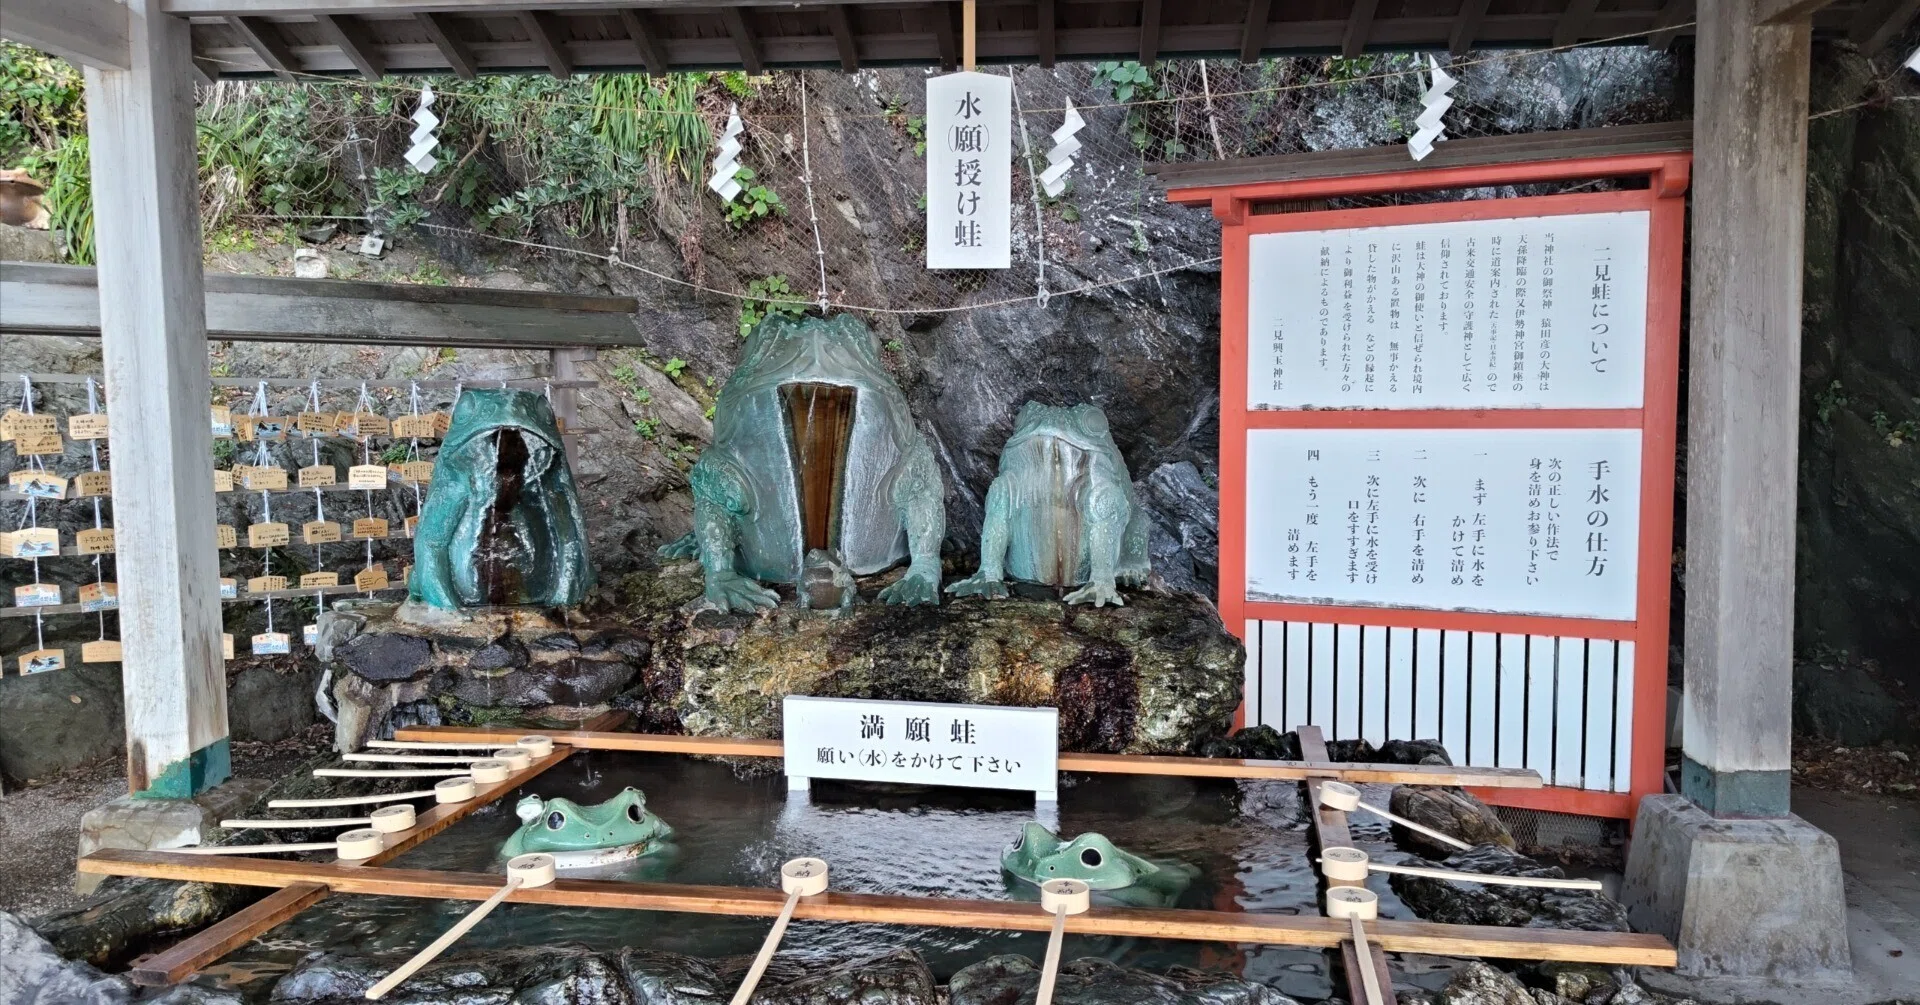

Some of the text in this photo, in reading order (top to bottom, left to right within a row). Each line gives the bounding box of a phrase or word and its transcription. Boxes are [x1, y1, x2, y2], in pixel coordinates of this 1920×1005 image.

[948, 91, 989, 247] 水（願）授け蛙
[1319, 247, 1330, 370] 献納によるものであります。
[1365, 244, 1377, 392] 貸した物がかえる などの縁起に
[1389, 243, 1401, 392] に沢山ある置物は 無事かえる
[1413, 241, 1426, 394] 蛙は大神の御使いと信ぜられ境内
[1438, 238, 1450, 335] 信仰されております。
[1462, 237, 1476, 392] 古来交通安全の守護神として広く
[1538, 233, 1554, 391] 当神社の御祭神 猿田彦の大神は
[1590, 247, 1611, 373] 二見蛙について
[1273, 319, 1283, 390] 二見興玉神社
[1306, 450, 1319, 581] 四 もう一度 左手を
[1414, 450, 1427, 459] 二
[1546, 458, 1562, 560] 次の正しい作法で
[1288, 528, 1300, 580] 清めます
[1346, 501, 1360, 584] 口をすすぎます
[1365, 450, 1380, 584] 三 次に左手に水を受け
[1412, 514, 1425, 584] 右手を清め
[1451, 516, 1465, 585] かけて清め
[1527, 458, 1542, 585] 身を清めお参り下さい
[1586, 460, 1610, 576] 手水の仕方
